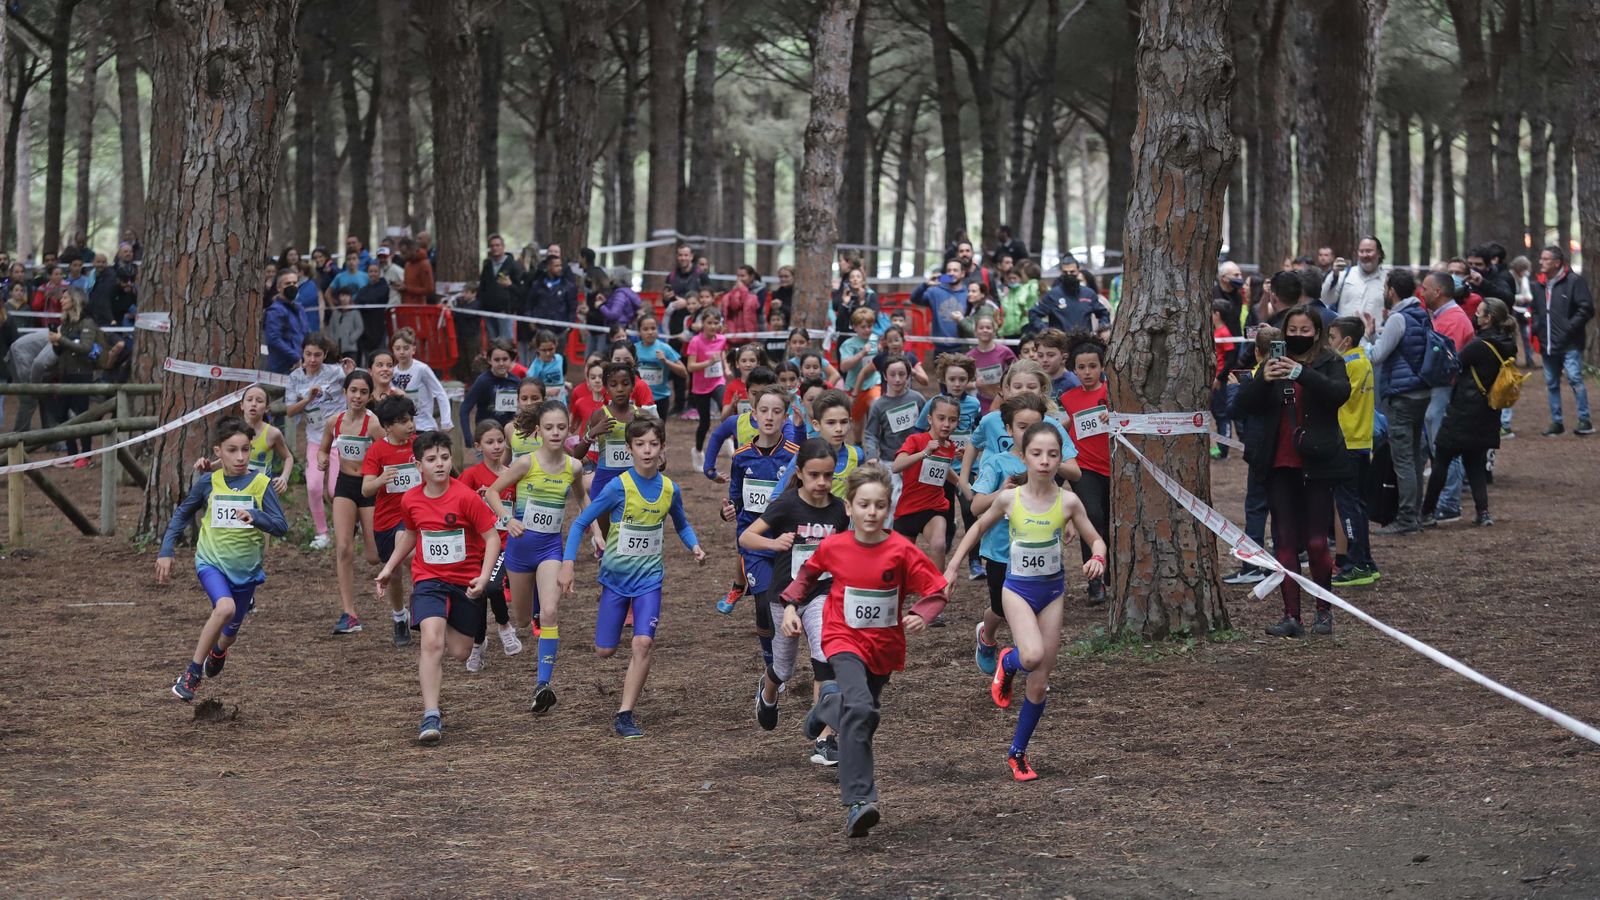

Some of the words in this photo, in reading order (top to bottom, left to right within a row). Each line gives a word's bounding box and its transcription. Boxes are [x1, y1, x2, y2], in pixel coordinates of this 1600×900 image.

[501, 398, 515, 407] 644
[896, 414, 911, 426] 695
[1081, 418, 1098, 431] 596
[343, 445, 360, 456] 663
[613, 451, 630, 461] 602
[929, 466, 945, 480] 622
[393, 475, 411, 487] 659
[749, 492, 767, 505] 520
[217, 508, 237, 520] 512
[533, 512, 553, 526] 680
[800, 522, 835, 538] JOY
[628, 537, 649, 549] 575
[429, 544, 449, 556] 693
[1022, 555, 1045, 568] 546
[855, 605, 881, 619] 682
